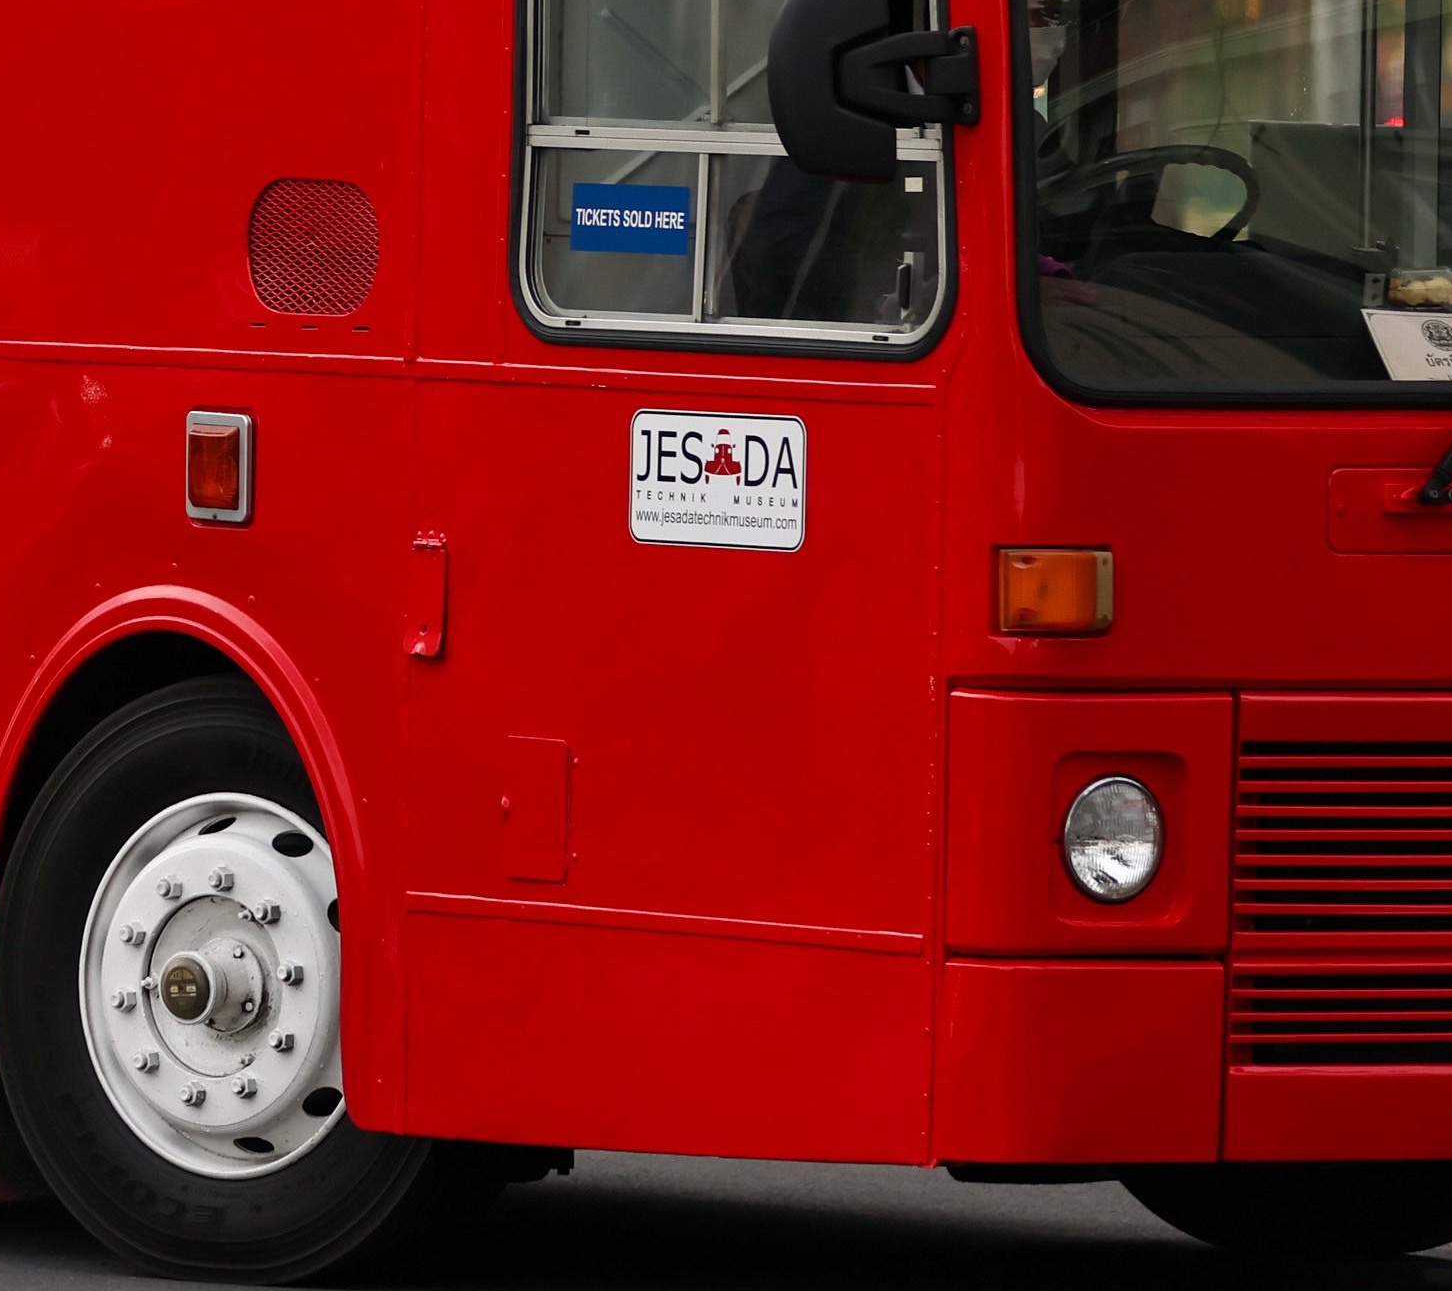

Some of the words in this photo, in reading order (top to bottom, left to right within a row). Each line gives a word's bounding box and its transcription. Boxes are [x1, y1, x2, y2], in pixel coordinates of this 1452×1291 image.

[576, 208, 621, 227] TICKETS
[622, 210, 653, 228] SOLD
[654, 211, 685, 230] HERE
[636, 489, 707, 504] TECHNIK
[733, 494, 799, 508] MUSEUM
[635, 508, 798, 531] www.jesadatechnikmuseum.com
